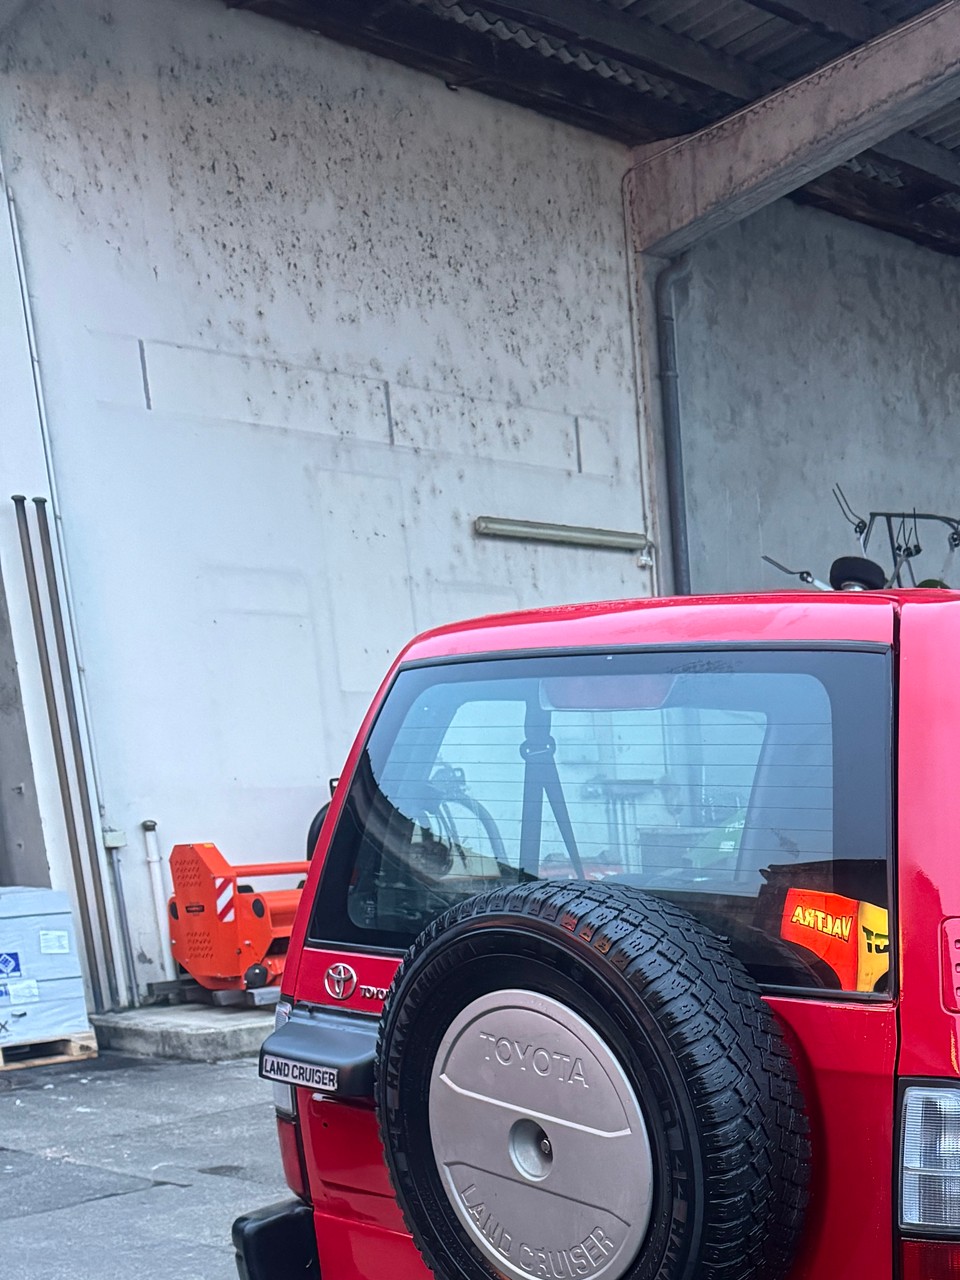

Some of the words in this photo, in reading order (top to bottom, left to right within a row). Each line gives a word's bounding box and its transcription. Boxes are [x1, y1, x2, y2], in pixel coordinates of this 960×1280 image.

[359, 984, 391, 1000] TOYO
[264, 1058, 290, 1078] LAND
[291, 1064, 336, 1088] CRUISER
[479, 1031, 590, 1089] TOYOTA
[461, 1183, 513, 1258] LAND
[518, 1225, 614, 1280] CRUISER
